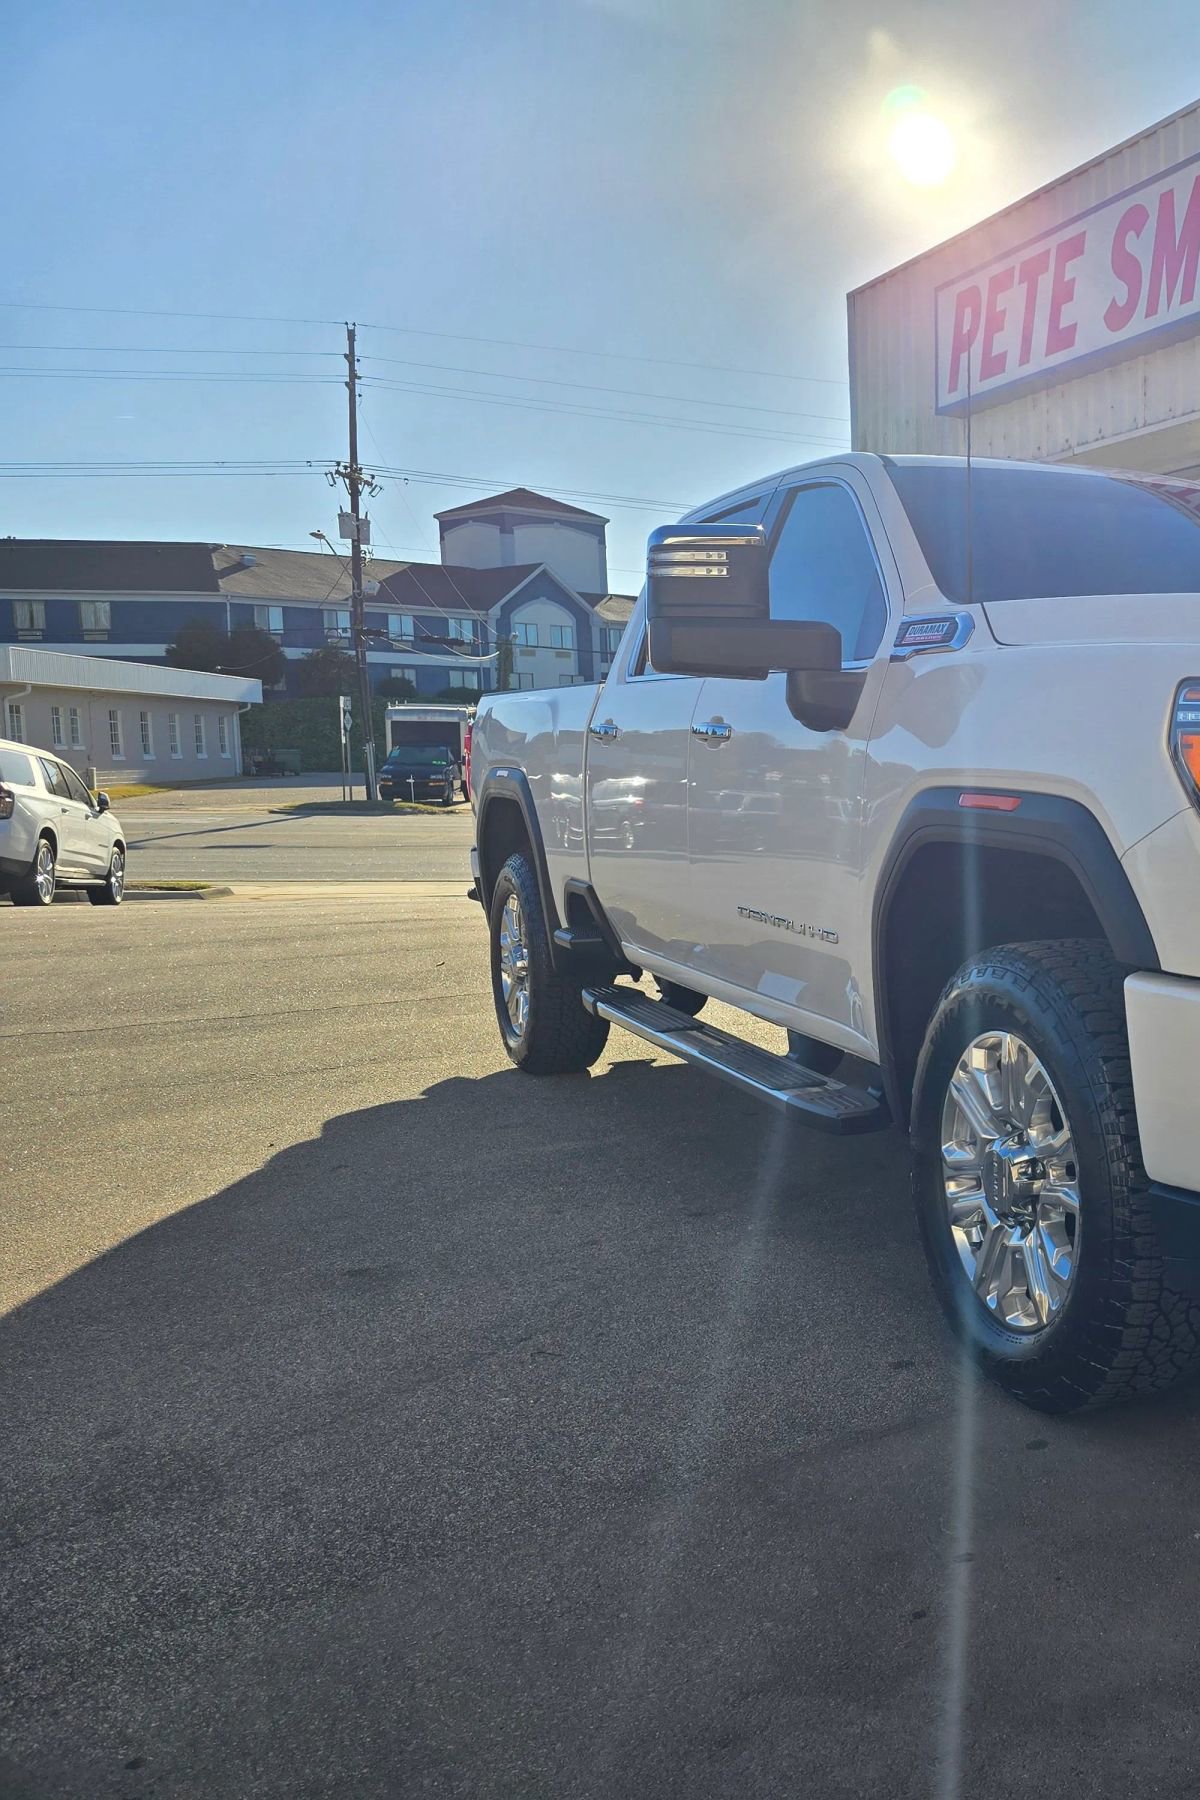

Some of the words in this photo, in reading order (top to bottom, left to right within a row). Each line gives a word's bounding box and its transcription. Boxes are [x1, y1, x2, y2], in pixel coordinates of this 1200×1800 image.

[948, 231, 1087, 394] PETE
[907, 622, 948, 637] DURAMAX
[737, 905, 806, 937] DENALI
